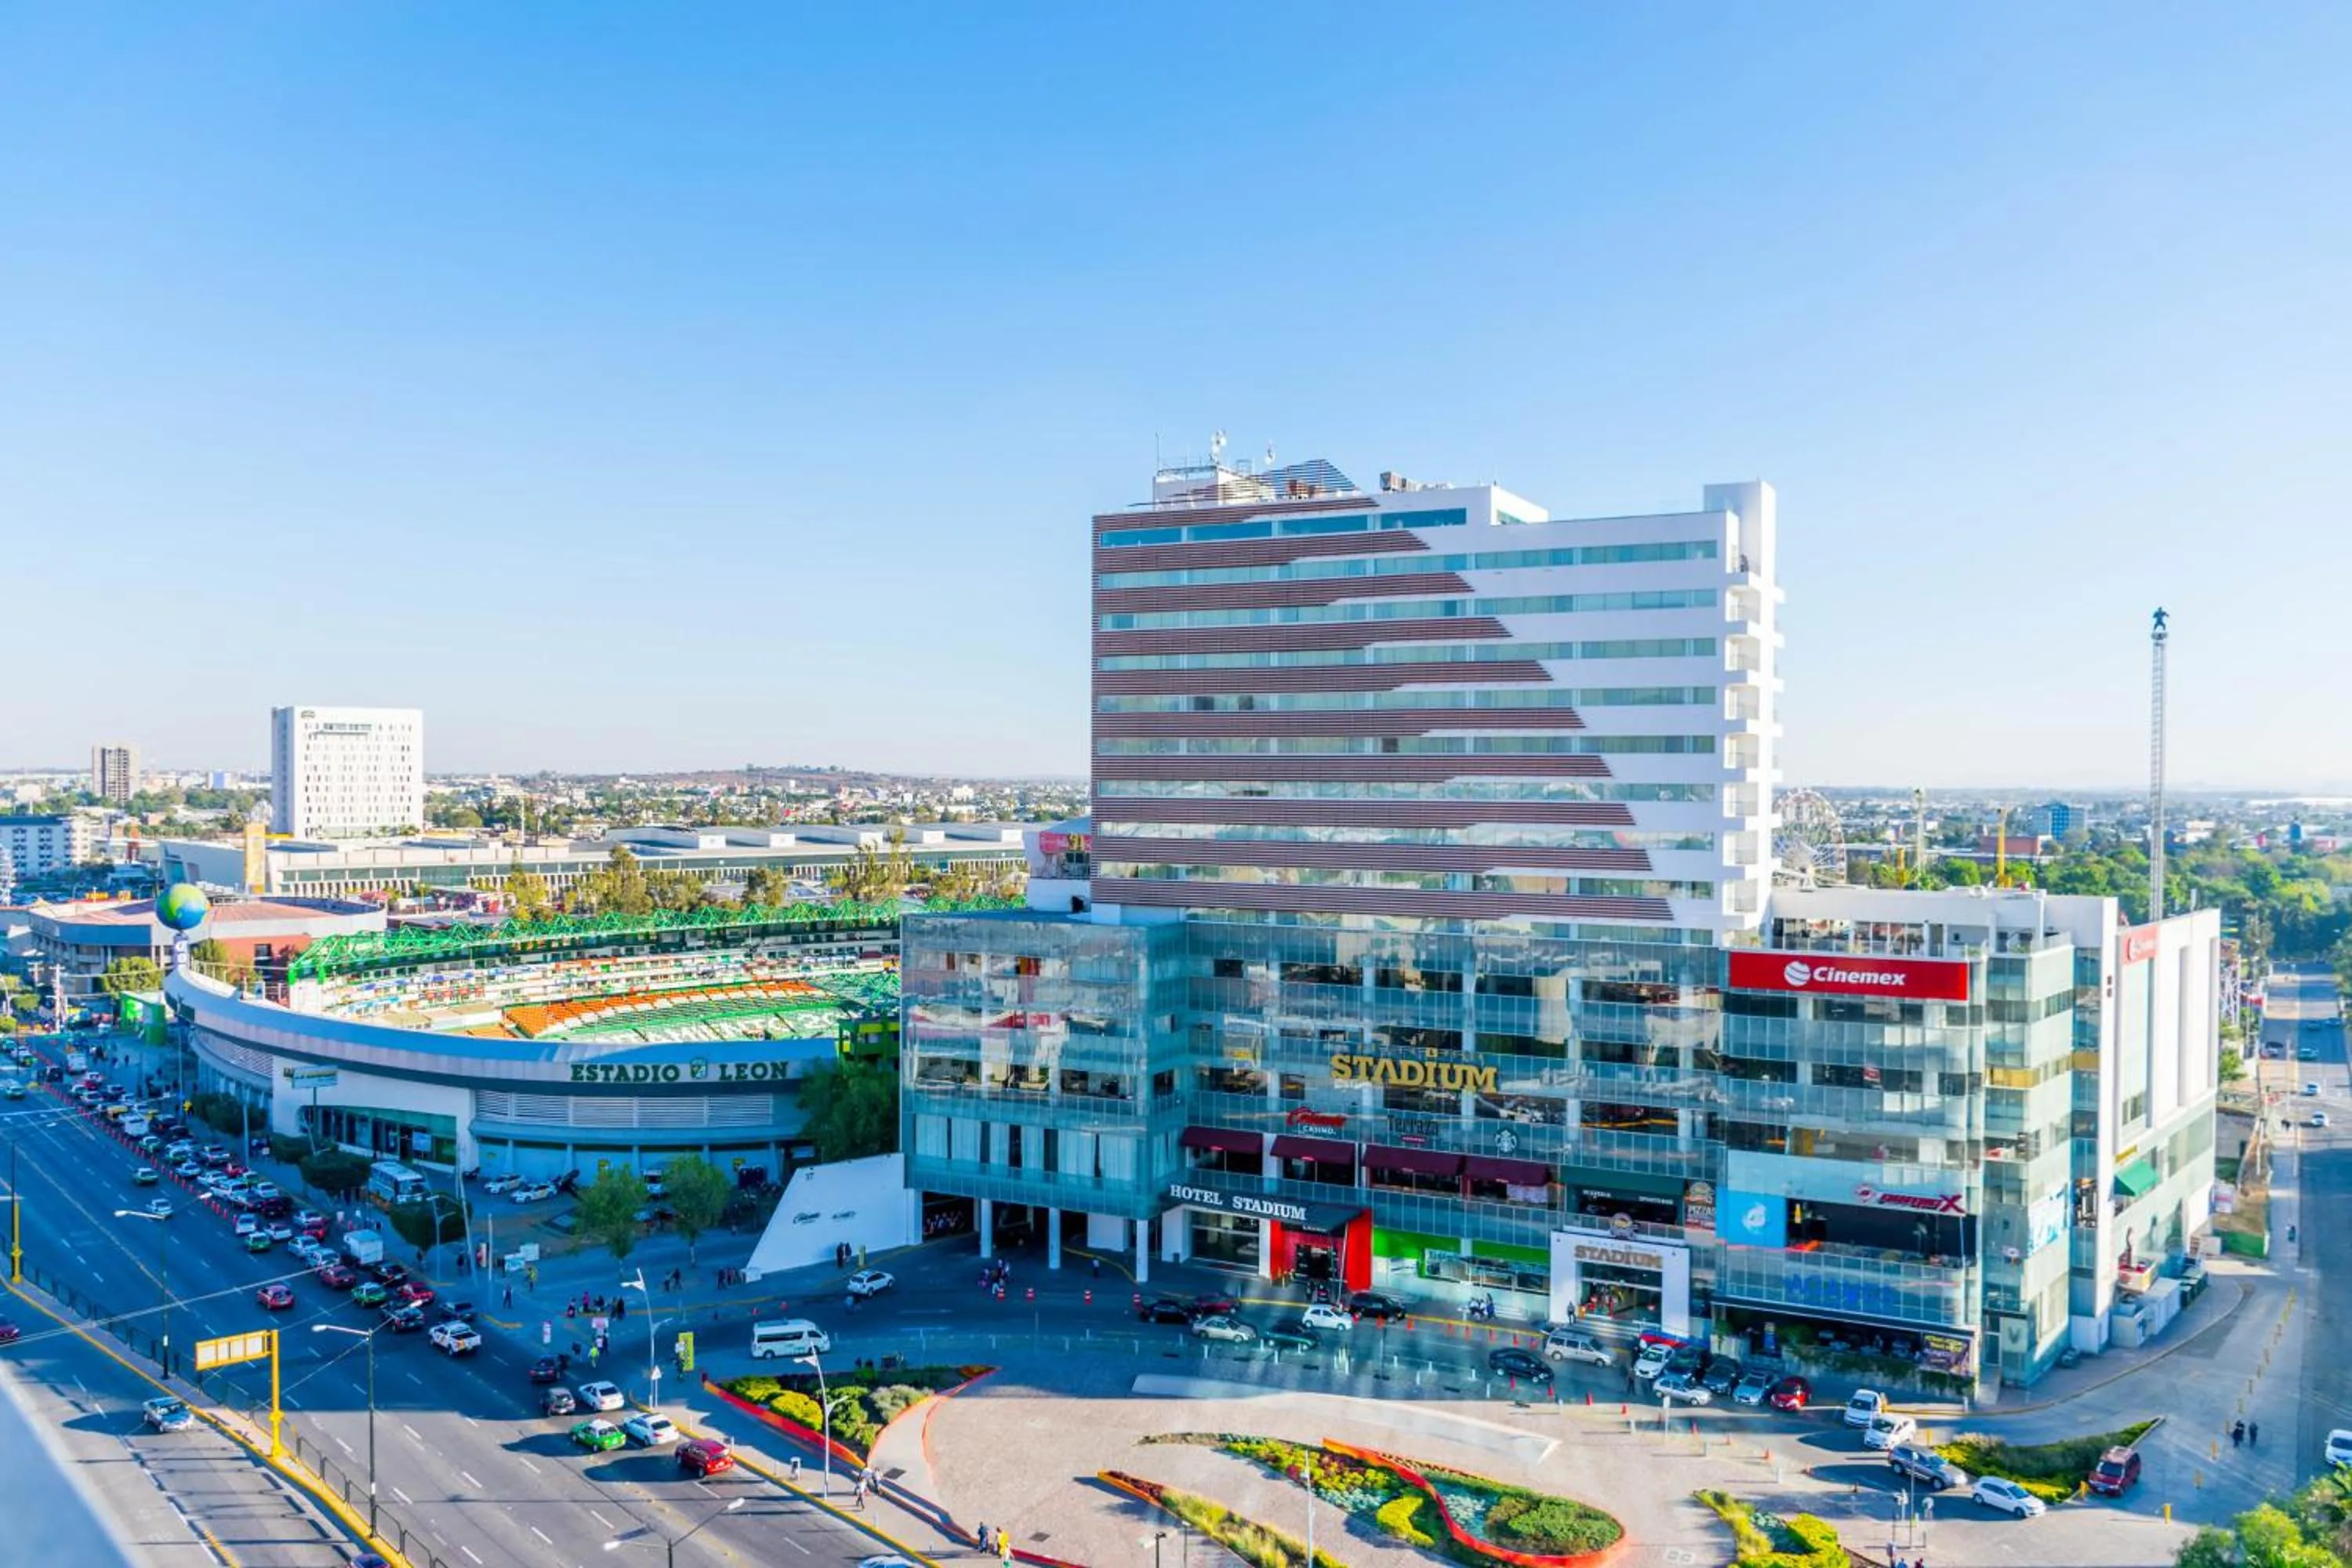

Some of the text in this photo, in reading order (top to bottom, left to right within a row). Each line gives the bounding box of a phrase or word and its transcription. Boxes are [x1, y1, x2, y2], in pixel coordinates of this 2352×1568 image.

[1813, 966, 1907, 985] Cinemex
[570, 1061, 789, 1082] ESTADIO LEON
[1330, 1053, 1497, 1093] STADIUM
[1387, 1114, 1439, 1136] Terraza
[1170, 1185, 1307, 1221] HOTEL STADIUM
[1574, 1245, 1663, 1269] STADIUM
